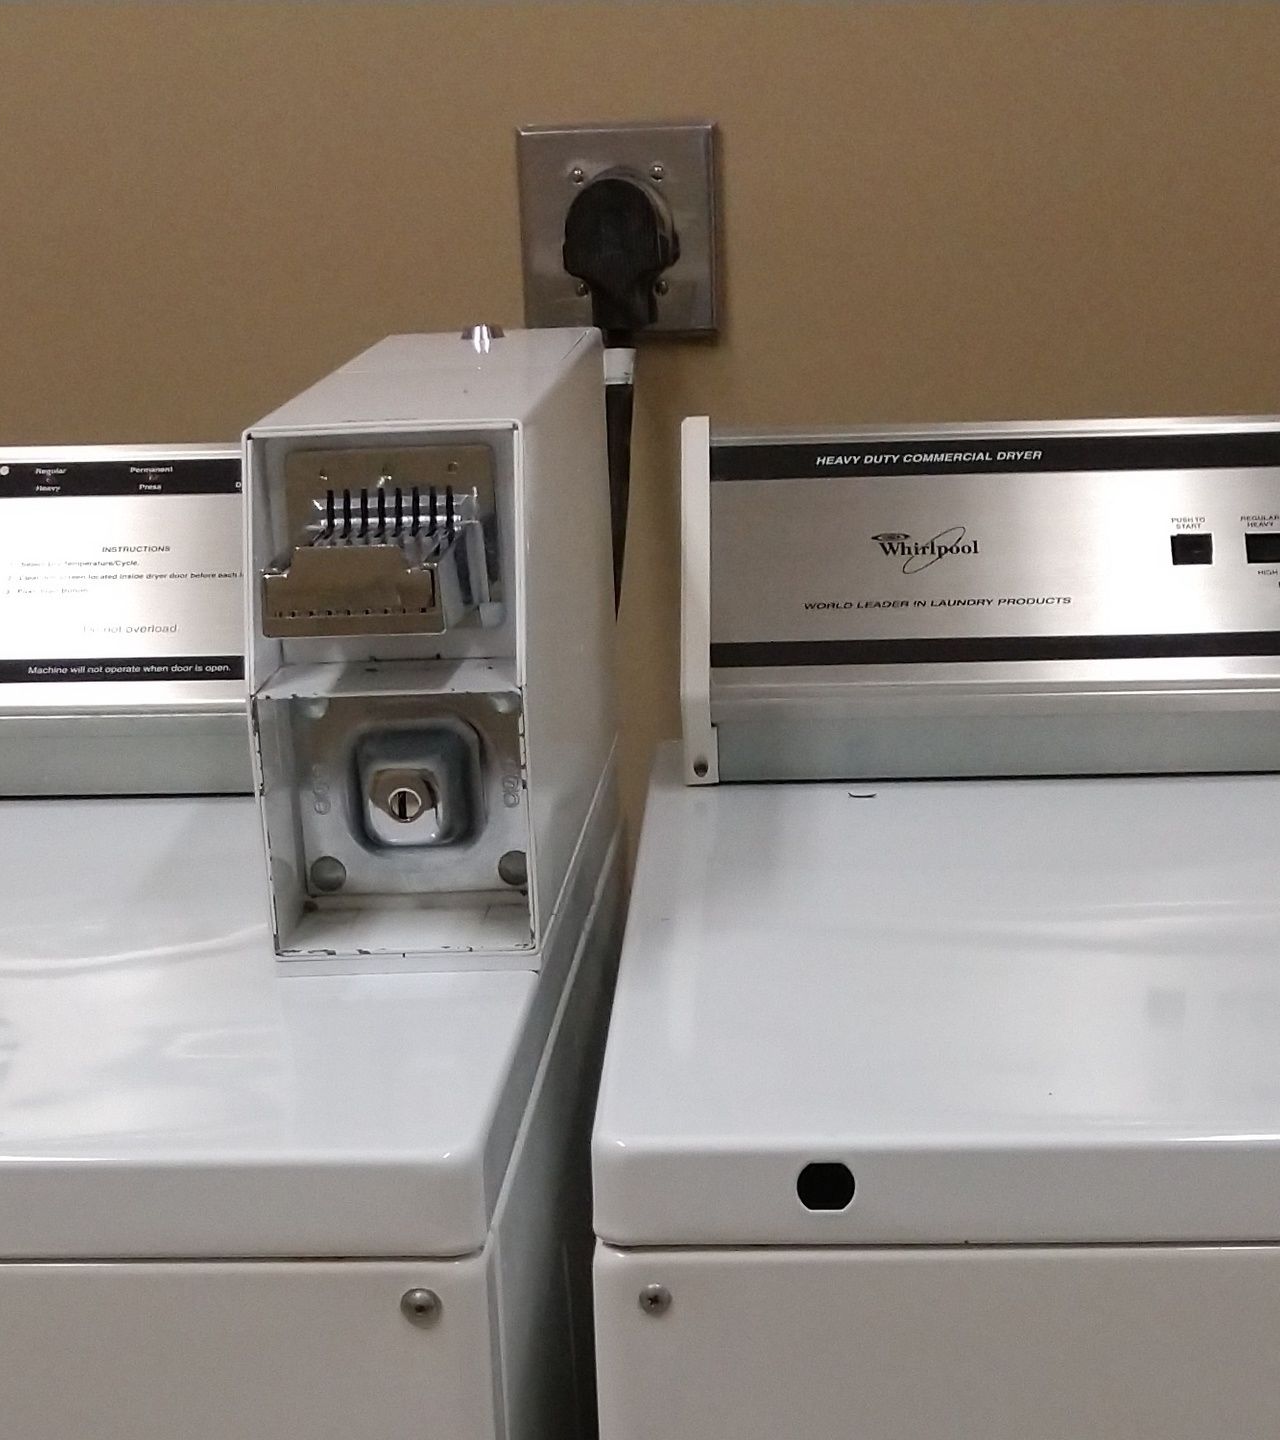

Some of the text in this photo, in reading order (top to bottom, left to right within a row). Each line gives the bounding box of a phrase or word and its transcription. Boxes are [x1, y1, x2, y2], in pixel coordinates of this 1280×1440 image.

[816, 450, 1042, 466] HEAVY DUTY COMMERCIAL DRYER
[35, 467, 66, 476] Regular
[130, 466, 174, 474] Permanent
[139, 483, 162, 491] Press
[804, 597, 1071, 610] WORLD LEADER IN LAUNDRY PRODUCTS
[28, 664, 231, 674] Machine will not operate when door is open.
